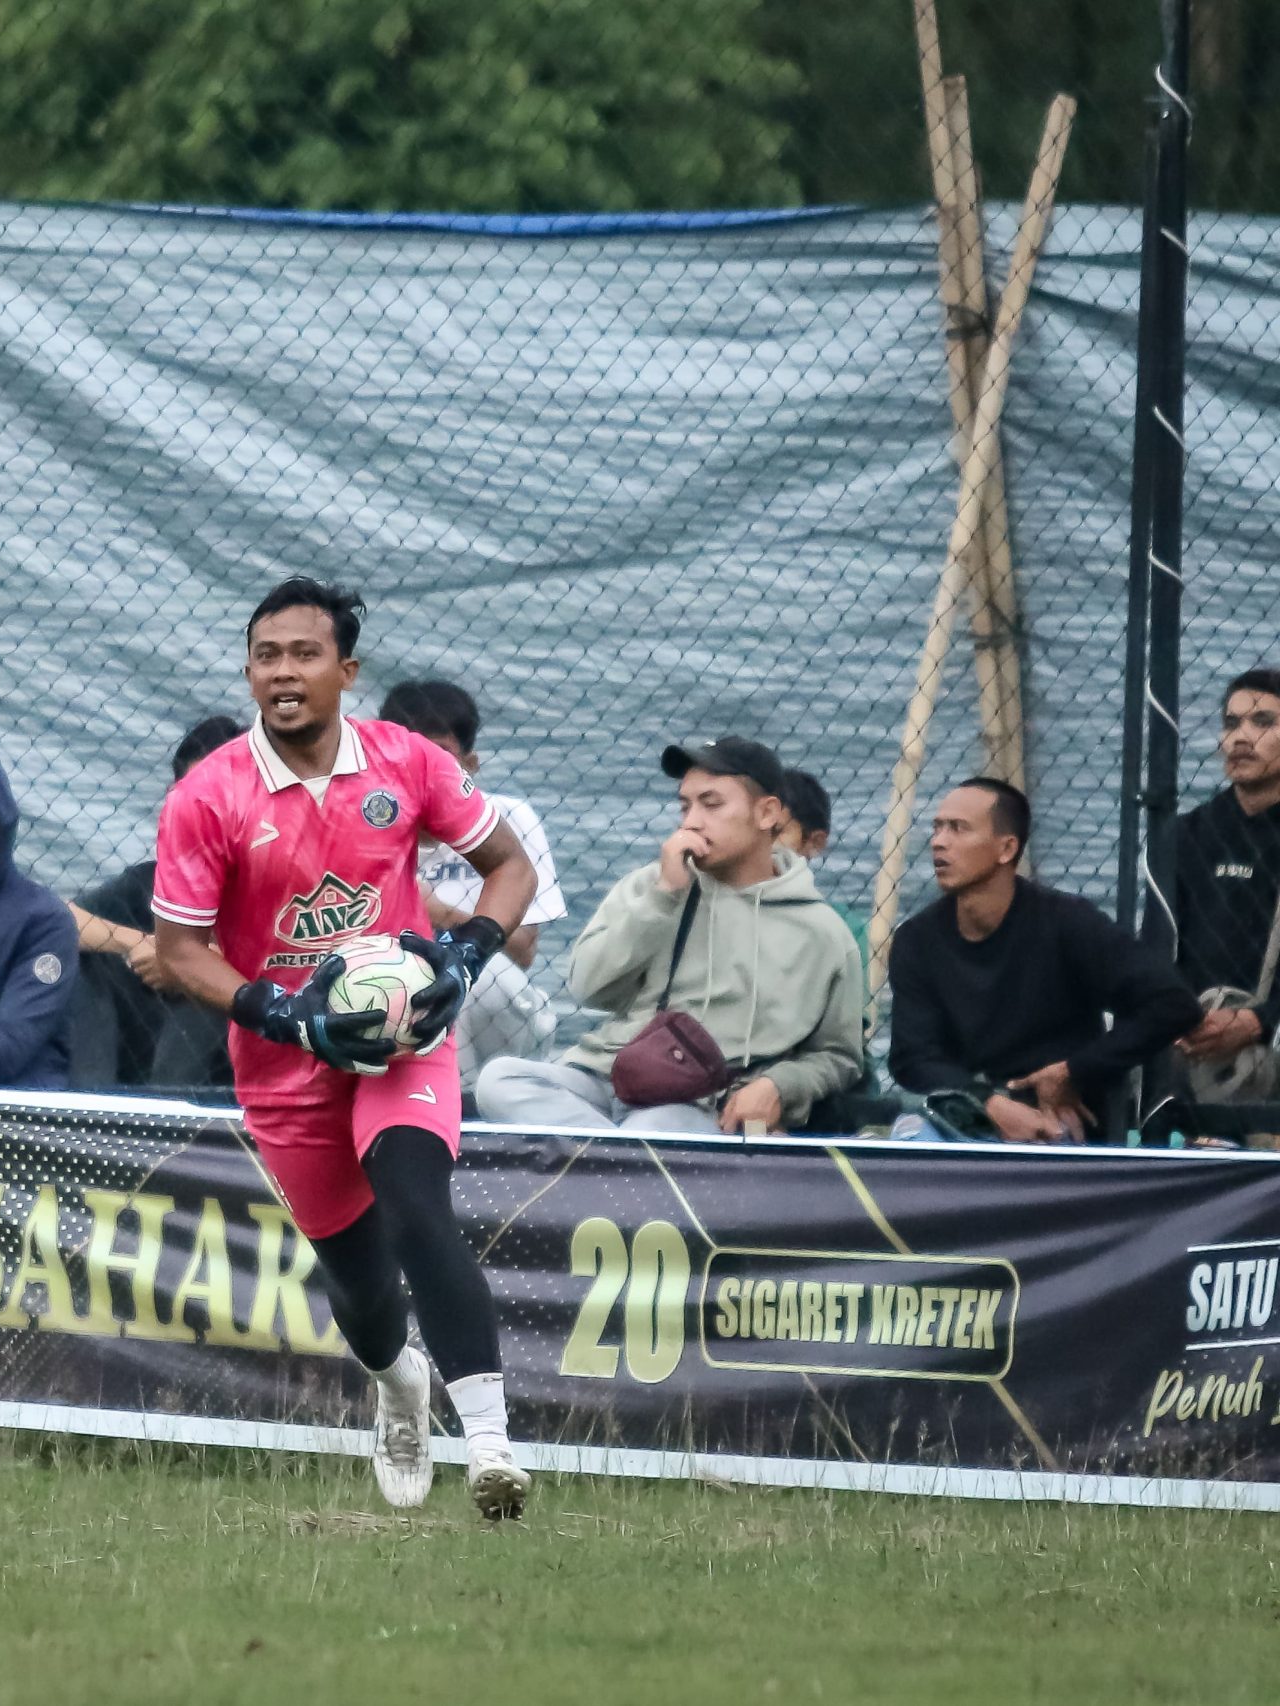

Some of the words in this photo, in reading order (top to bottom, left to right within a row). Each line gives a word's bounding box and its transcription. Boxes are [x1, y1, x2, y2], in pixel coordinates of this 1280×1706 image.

[292, 899, 370, 940] ANZ
[266, 955, 297, 970] ANZ
[559, 1217, 691, 1384] 20
[716, 1276, 865, 1344] SIGARET
[867, 1283, 1003, 1350] KRETEK
[1186, 1256, 1279, 1332] SATU
